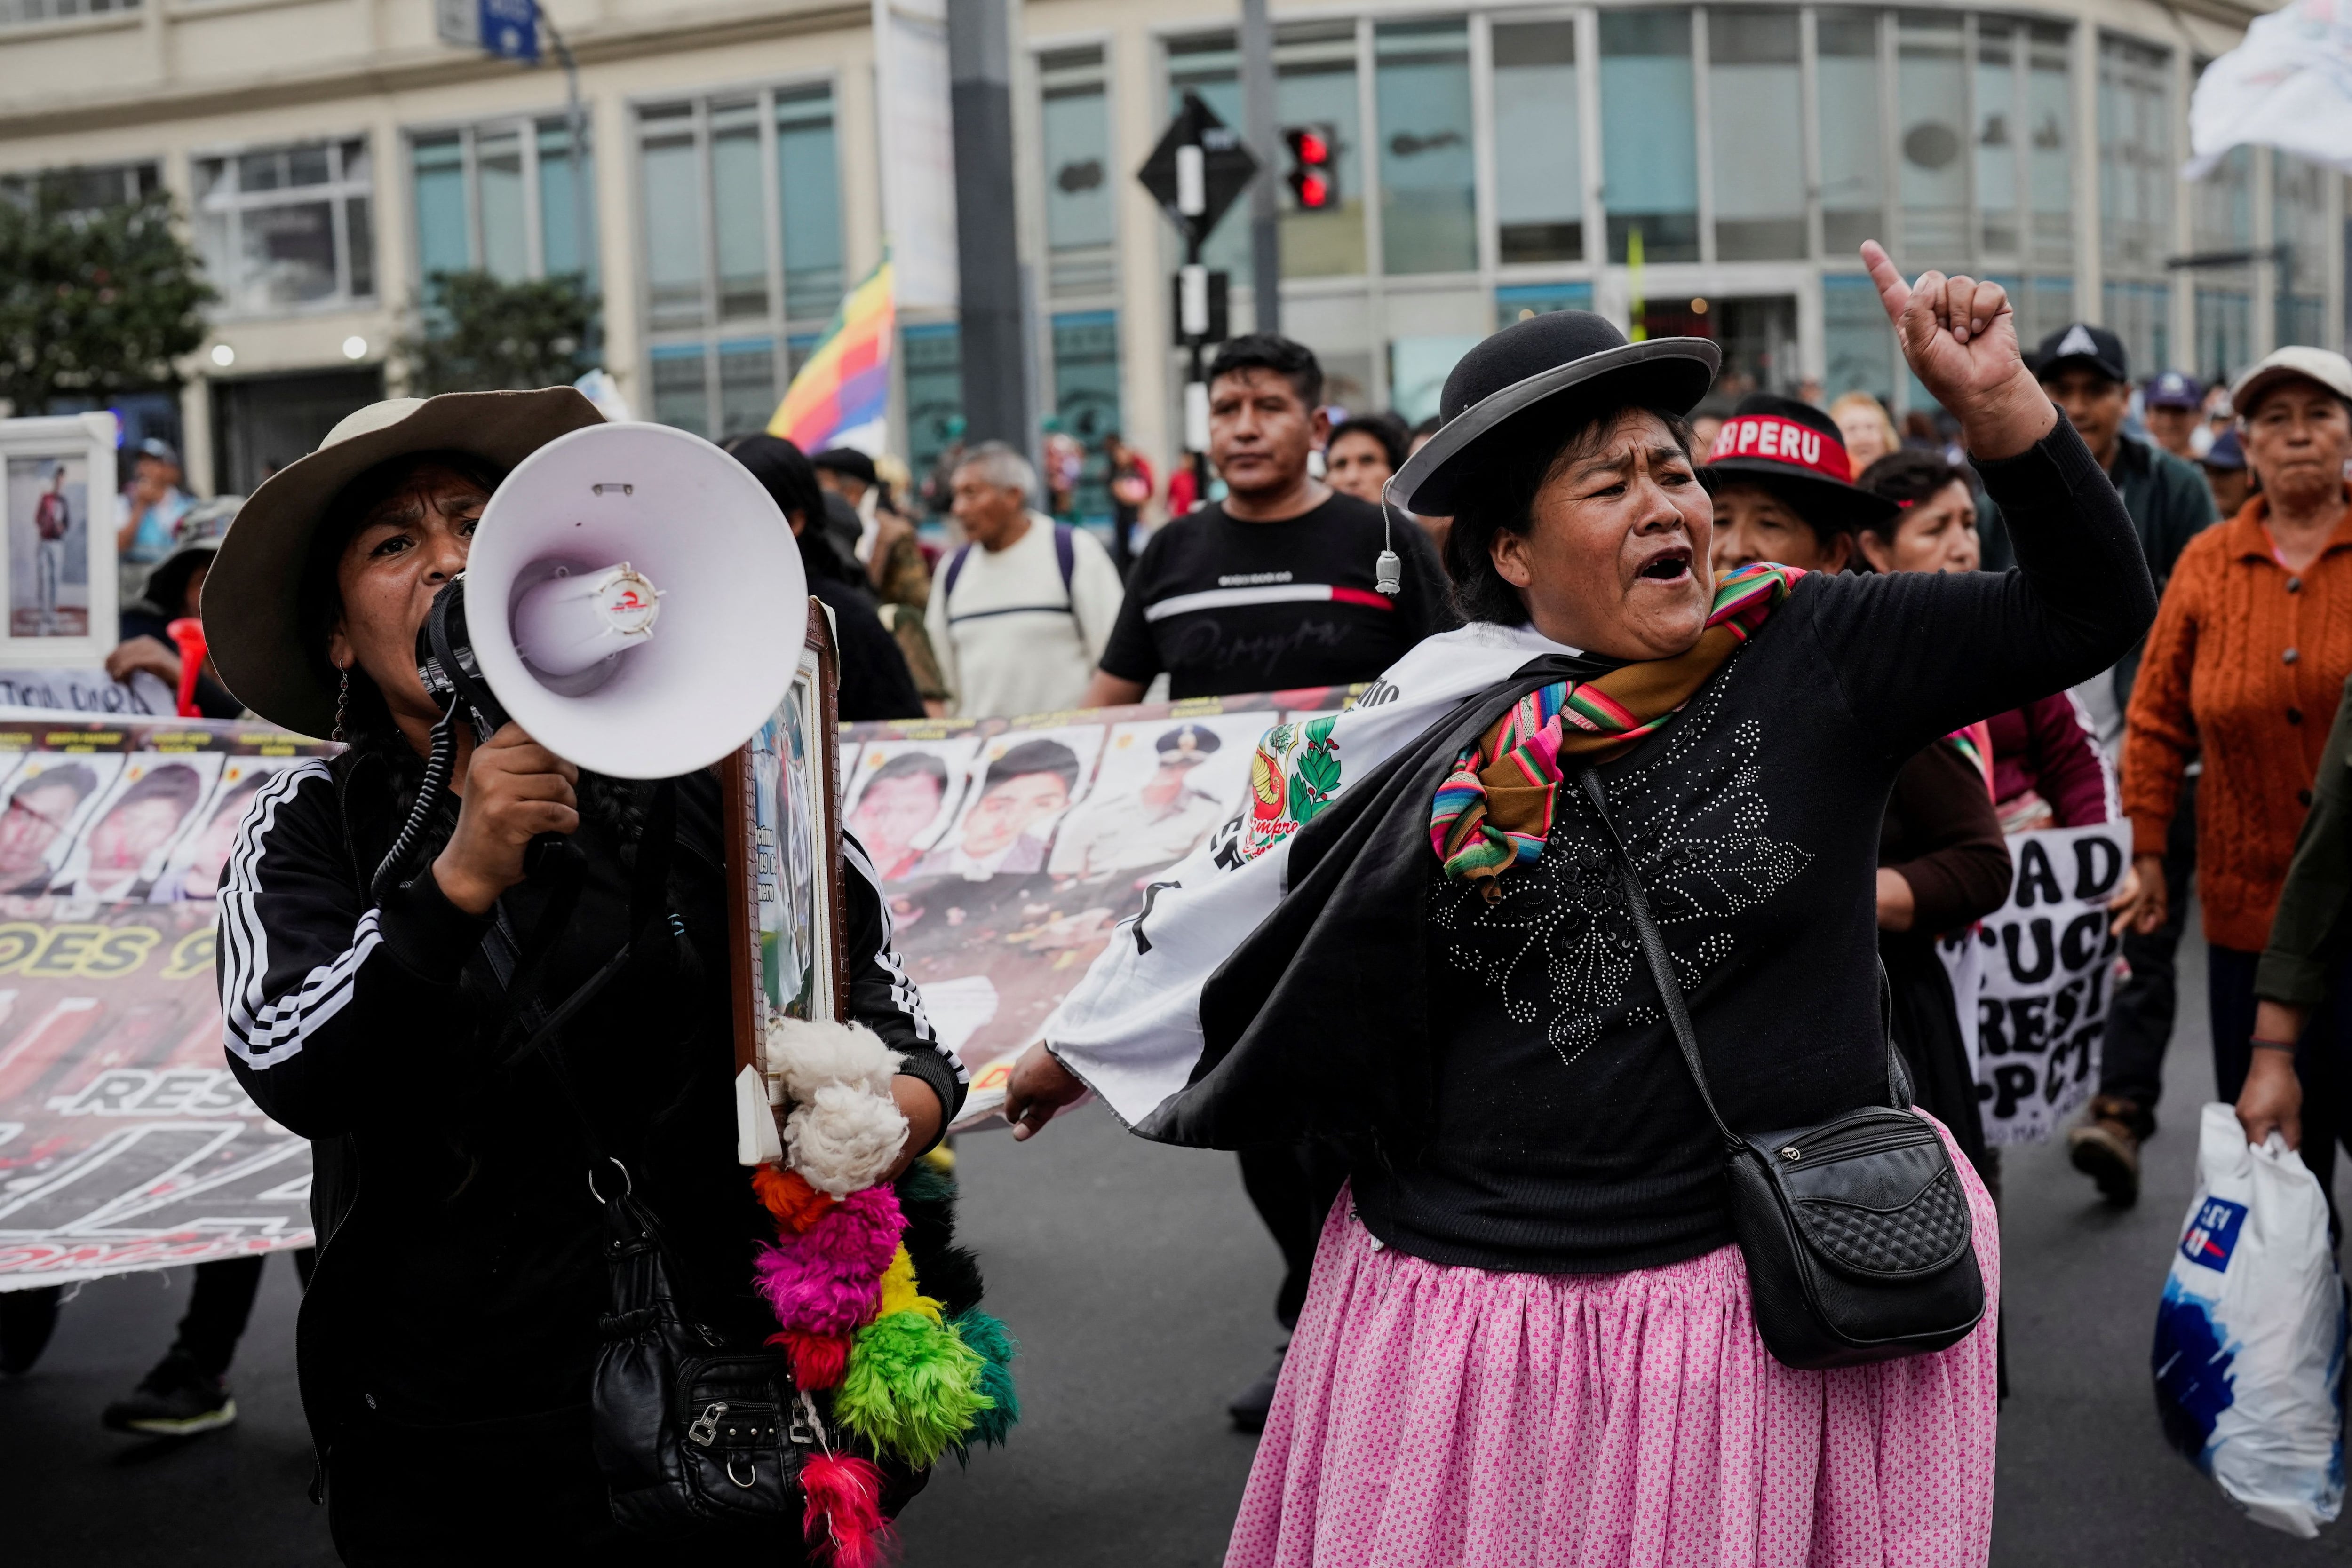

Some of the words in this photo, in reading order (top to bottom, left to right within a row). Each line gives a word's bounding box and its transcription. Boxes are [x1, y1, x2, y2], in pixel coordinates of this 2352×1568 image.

[1738, 420, 1820, 465] PERU
[758, 883, 774, 902] nero
[2015, 837, 2122, 908] AD
[45, 1068, 261, 1117] RES
